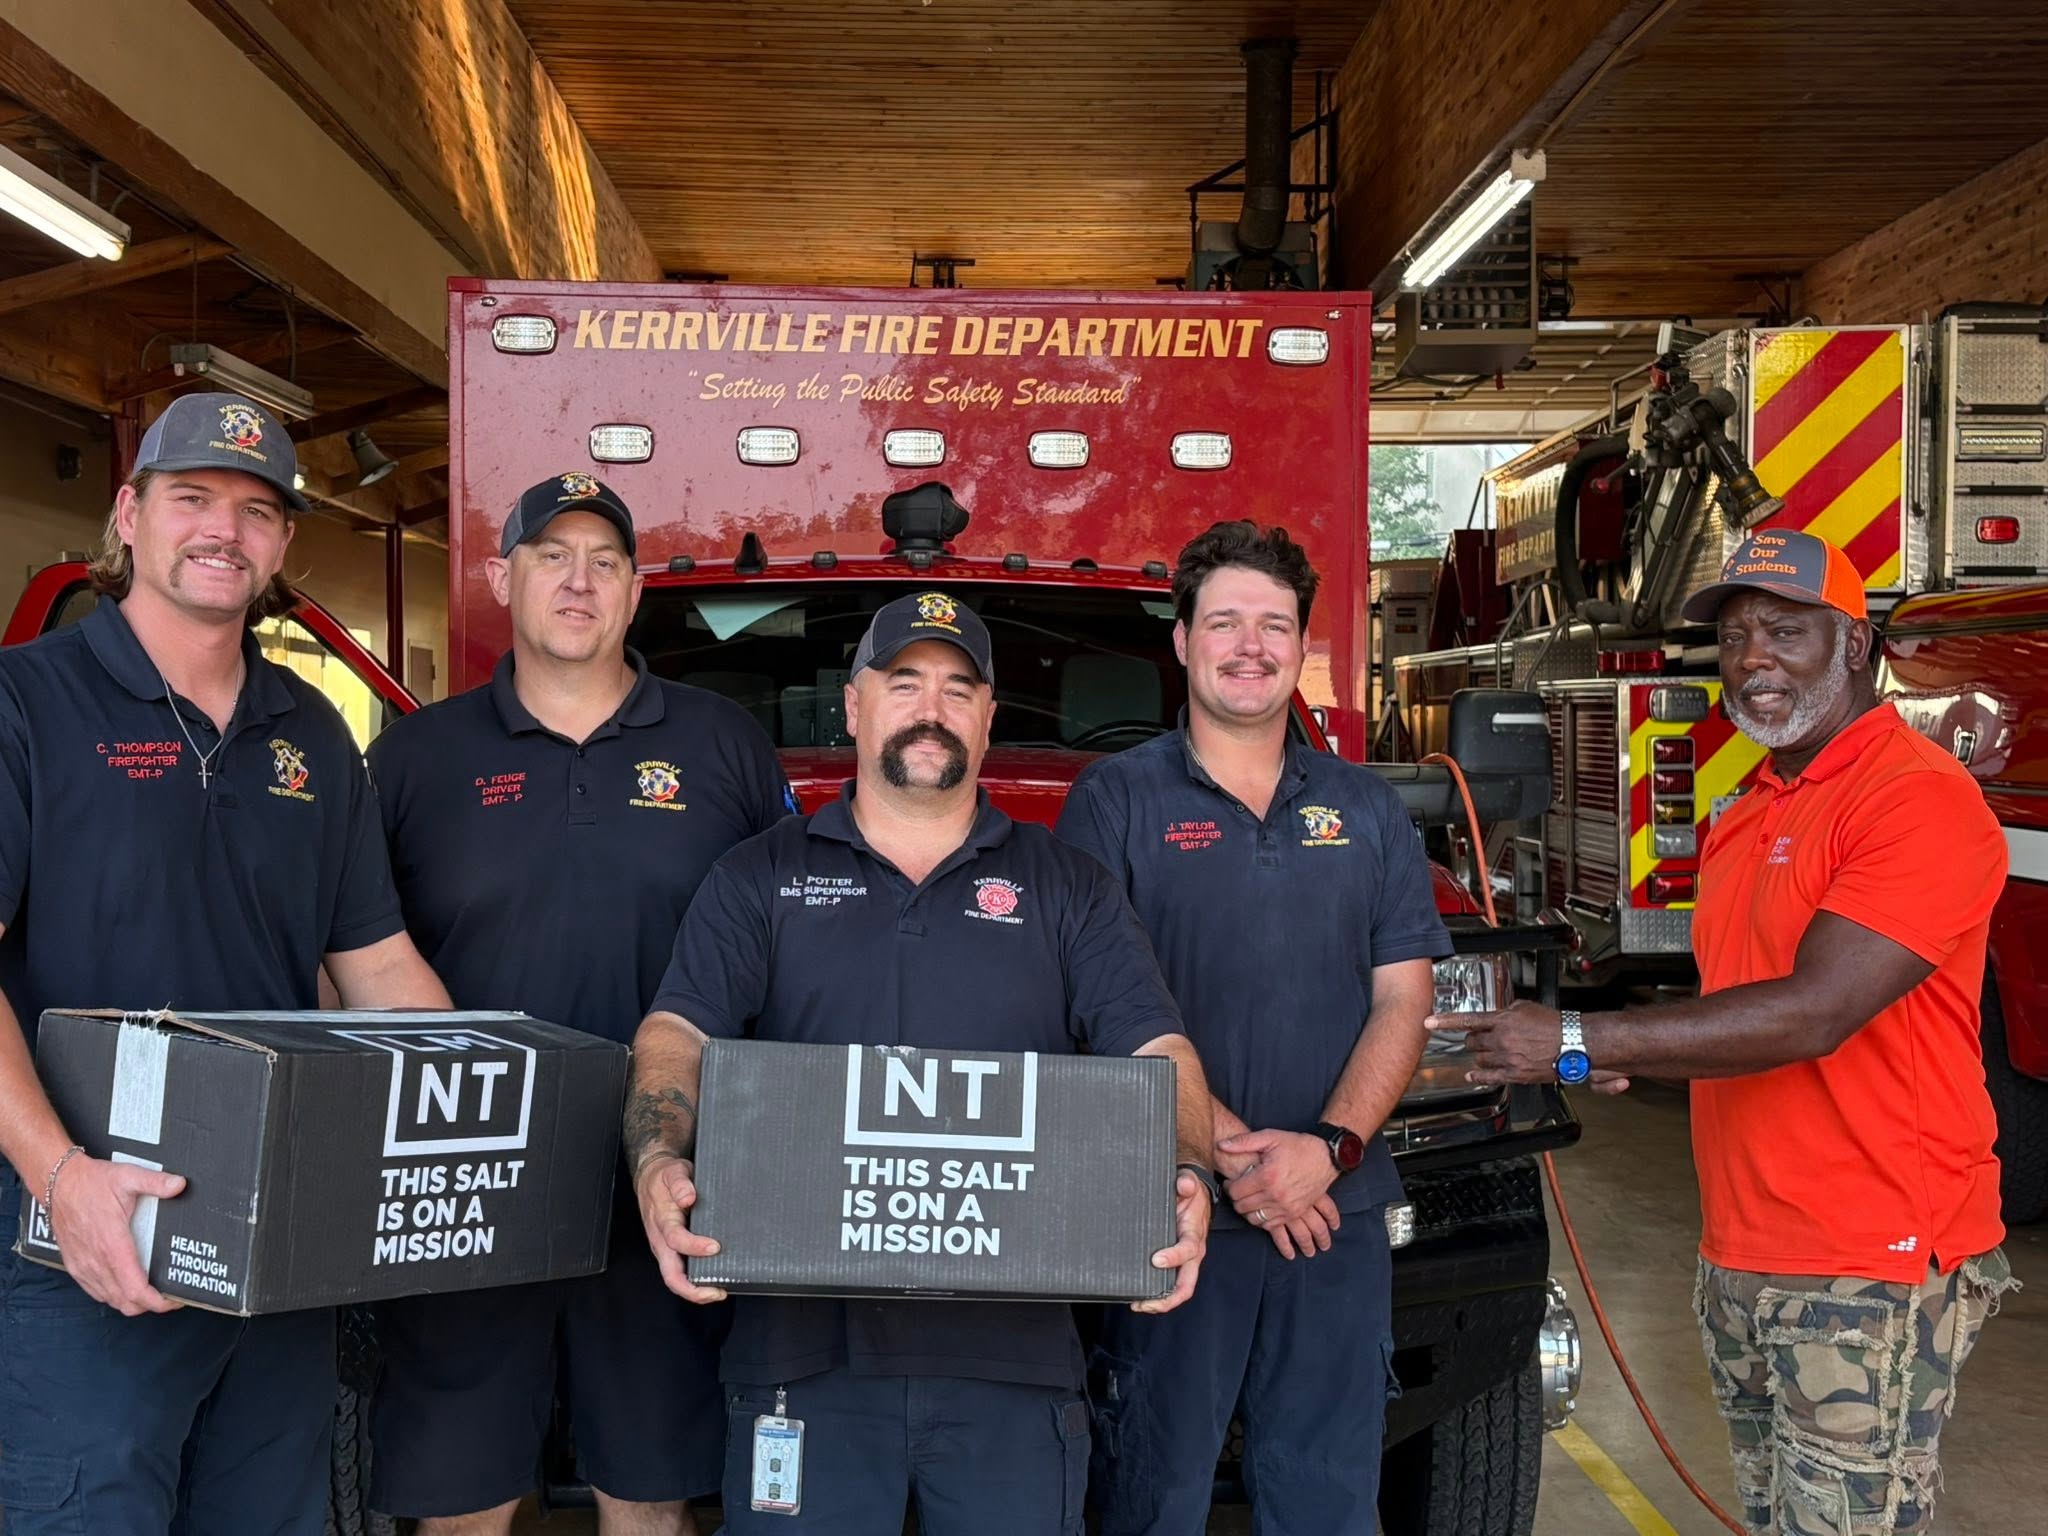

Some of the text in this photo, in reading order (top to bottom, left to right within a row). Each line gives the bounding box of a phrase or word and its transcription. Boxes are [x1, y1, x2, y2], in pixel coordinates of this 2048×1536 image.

[573, 310, 1264, 358] KERRVILLE FIRE DEPARTMENT
[796, 372, 830, 401] the
[839, 373, 915, 403] Public
[923, 376, 1004, 412] Safety
[1497, 477, 1559, 531] KERRVIL
[1749, 547, 1779, 558] Our
[1752, 535, 1788, 546] Save
[1735, 560, 1798, 576] Students
[96, 741, 182, 754] C. THOMPSON
[108, 755, 178, 767] FIREFIGHTER
[127, 769, 163, 779] EMT-P
[482, 784, 521, 796] DRIVER
[1179, 821, 1216, 831] TAYLOR
[780, 886, 868, 897] EMS SUPERVISOR
[806, 876, 853, 887] POTTER
[805, 896, 841, 906] EMT-P
[416, 1062, 509, 1124] NT
[884, 1056, 1000, 1120] NT
[381, 1160, 525, 1197] THIS SALT
[843, 1156, 1035, 1191] THIS SALT
[376, 1195, 484, 1232] IS ON A
[842, 1189, 985, 1222] IS ON A
[170, 1234, 217, 1259] HEALTH
[373, 1226, 495, 1266] MISSION
[840, 1222, 1000, 1256] MISSION
[170, 1250, 228, 1278] THROUGH
[167, 1266, 237, 1297] HYDRATION
